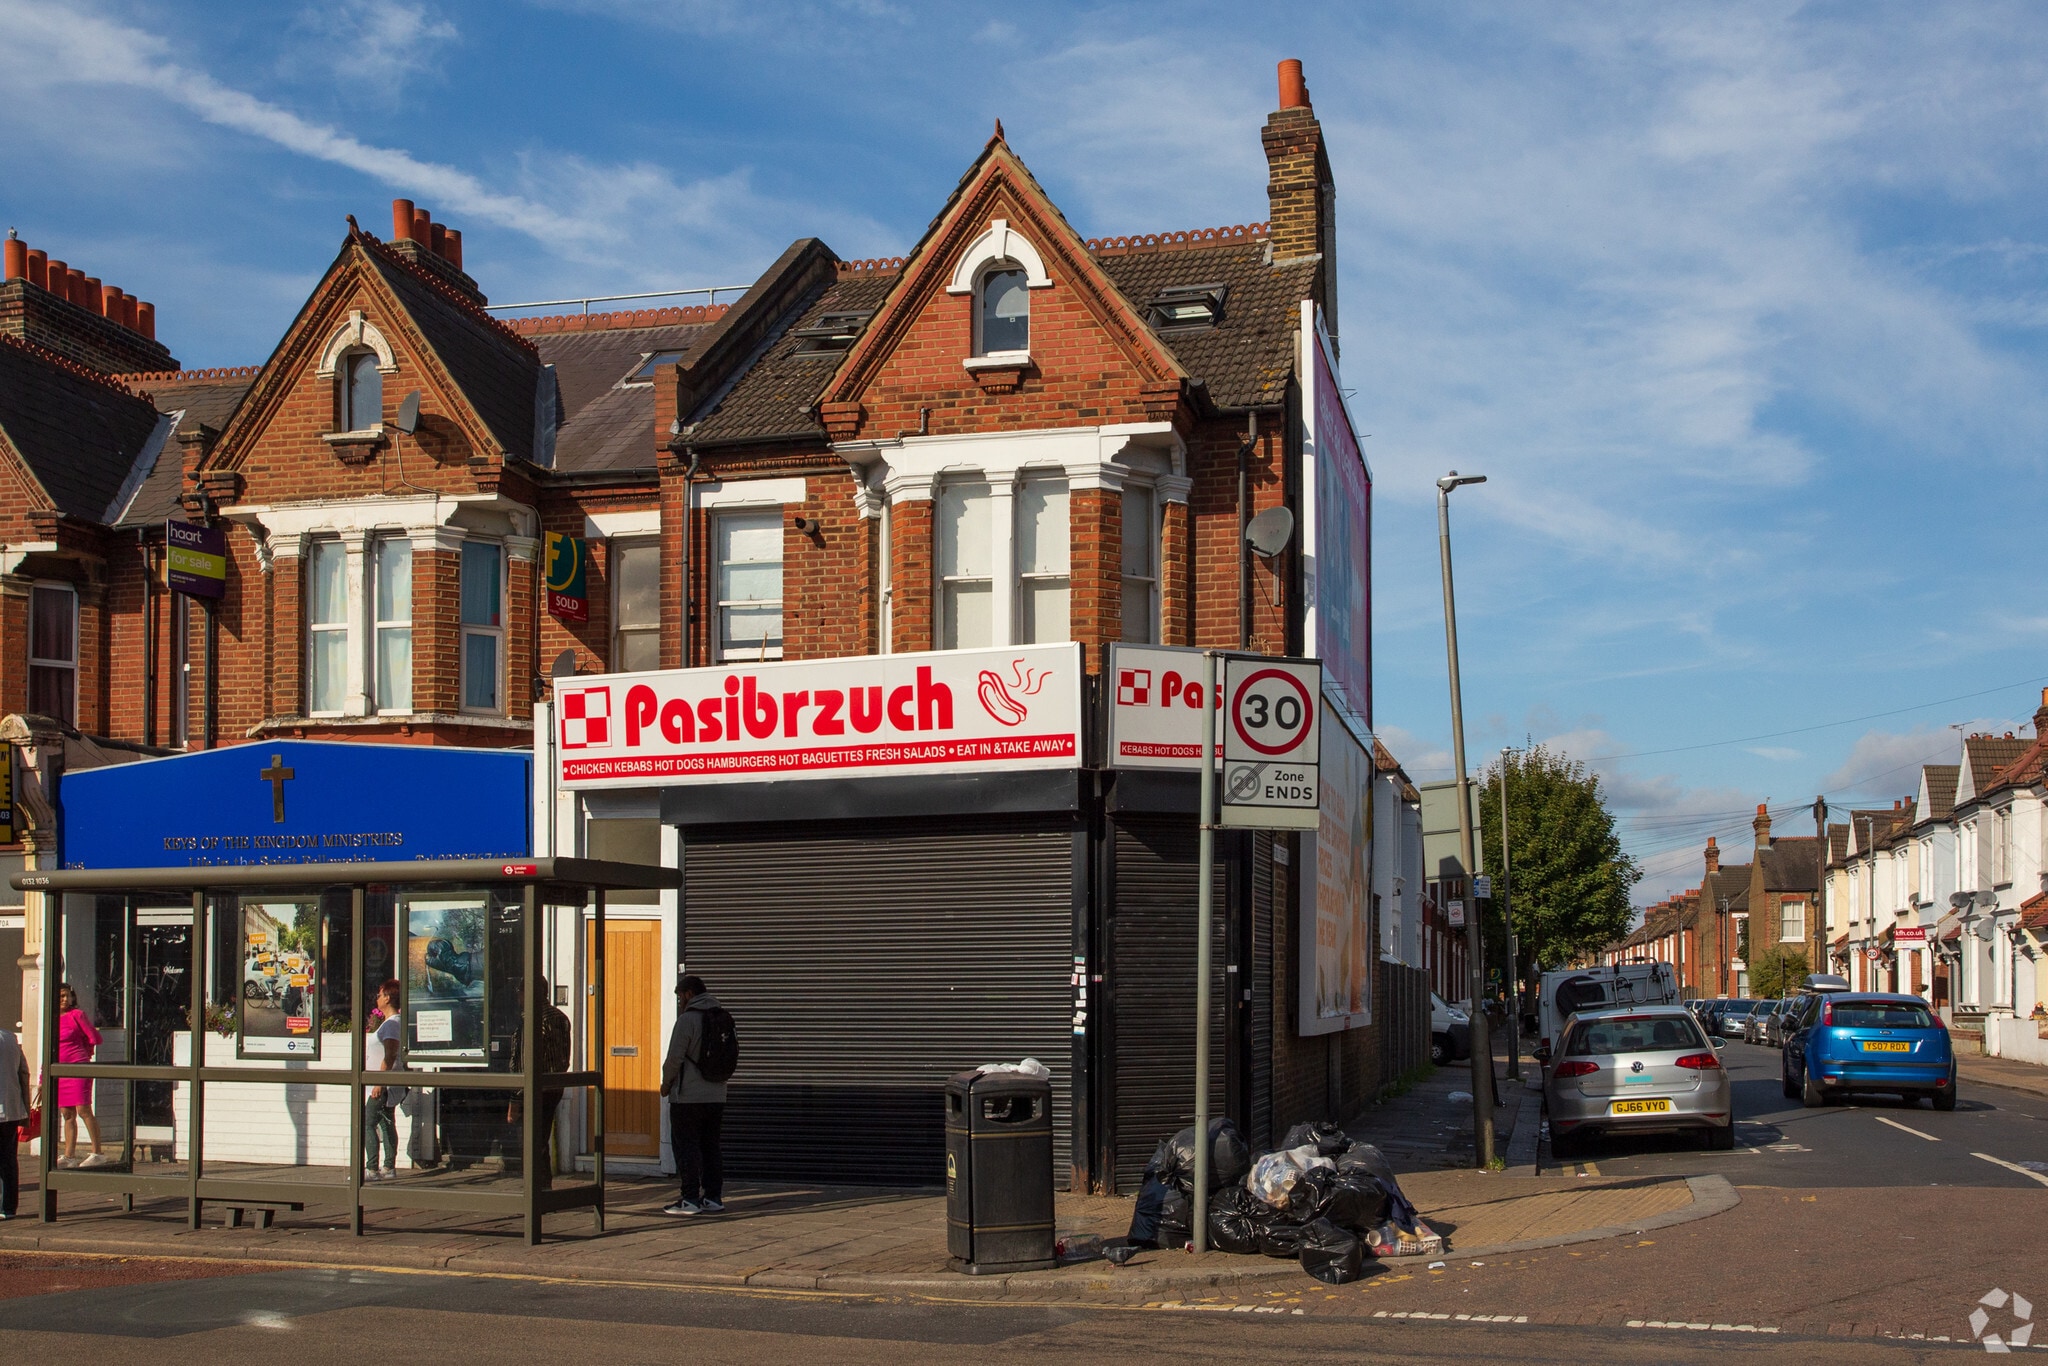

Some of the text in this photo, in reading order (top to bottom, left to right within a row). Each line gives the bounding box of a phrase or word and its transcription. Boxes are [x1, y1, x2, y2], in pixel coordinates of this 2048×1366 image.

[170, 523, 202, 543] haart
[170, 550, 212, 570] for sale
[555, 595, 579, 610] SOLD
[625, 666, 953, 747] Pasibrzuch
[1244, 694, 1301, 730] 30
[570, 763, 612, 775] CHICKEN
[614, 760, 653, 773] KEBABS
[654, 760, 674, 771] HOT
[676, 758, 705, 770] DOGS
[707, 755, 776, 769] HAMBURGERS
[779, 754, 800, 766] HOT
[802, 749, 863, 765] BAGUETTES
[865, 748, 901, 761] FRESH
[903, 745, 946, 760] SALADS
[957, 743, 977, 756] EAT
[979, 742, 991, 754] IN
[1033, 739, 1065, 753] AWAY
[1121, 745, 1153, 755] KEBABS
[1154, 746, 1170, 755] HOT
[1172, 747, 1194, 756] DOGS
[1274, 770, 1305, 782] Zone
[1265, 786, 1313, 800] ENDS
[163, 832, 403, 850] KEYS OF THE KINGDOM MINISTRIES
[1866, 1042, 1907, 1051] YS07 RDX
[1616, 1102, 1666, 1113] GJ66 VYO
